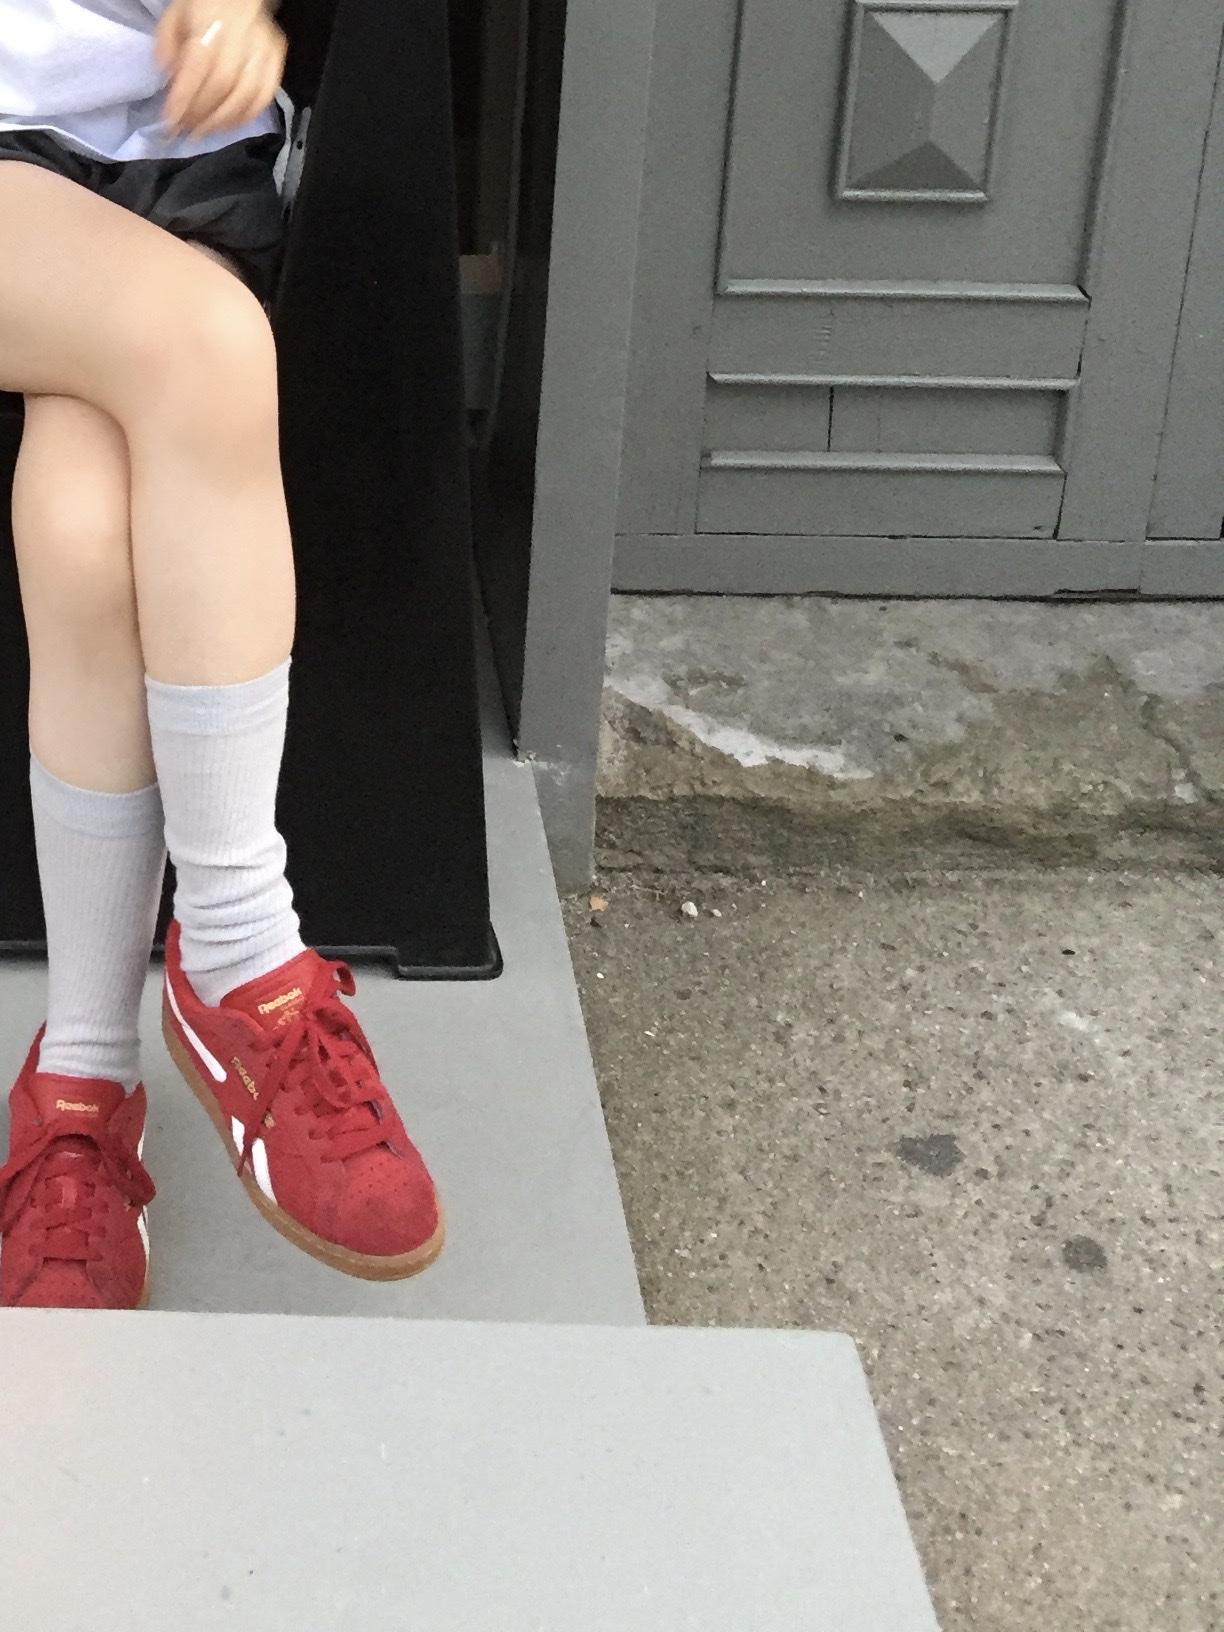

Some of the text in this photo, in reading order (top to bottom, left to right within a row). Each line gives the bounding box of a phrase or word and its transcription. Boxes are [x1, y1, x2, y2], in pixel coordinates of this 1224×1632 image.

[258, 987, 303, 1015] Reebok
[231, 1056, 259, 1101] Reeb
[56, 1099, 100, 1113] Reebok
